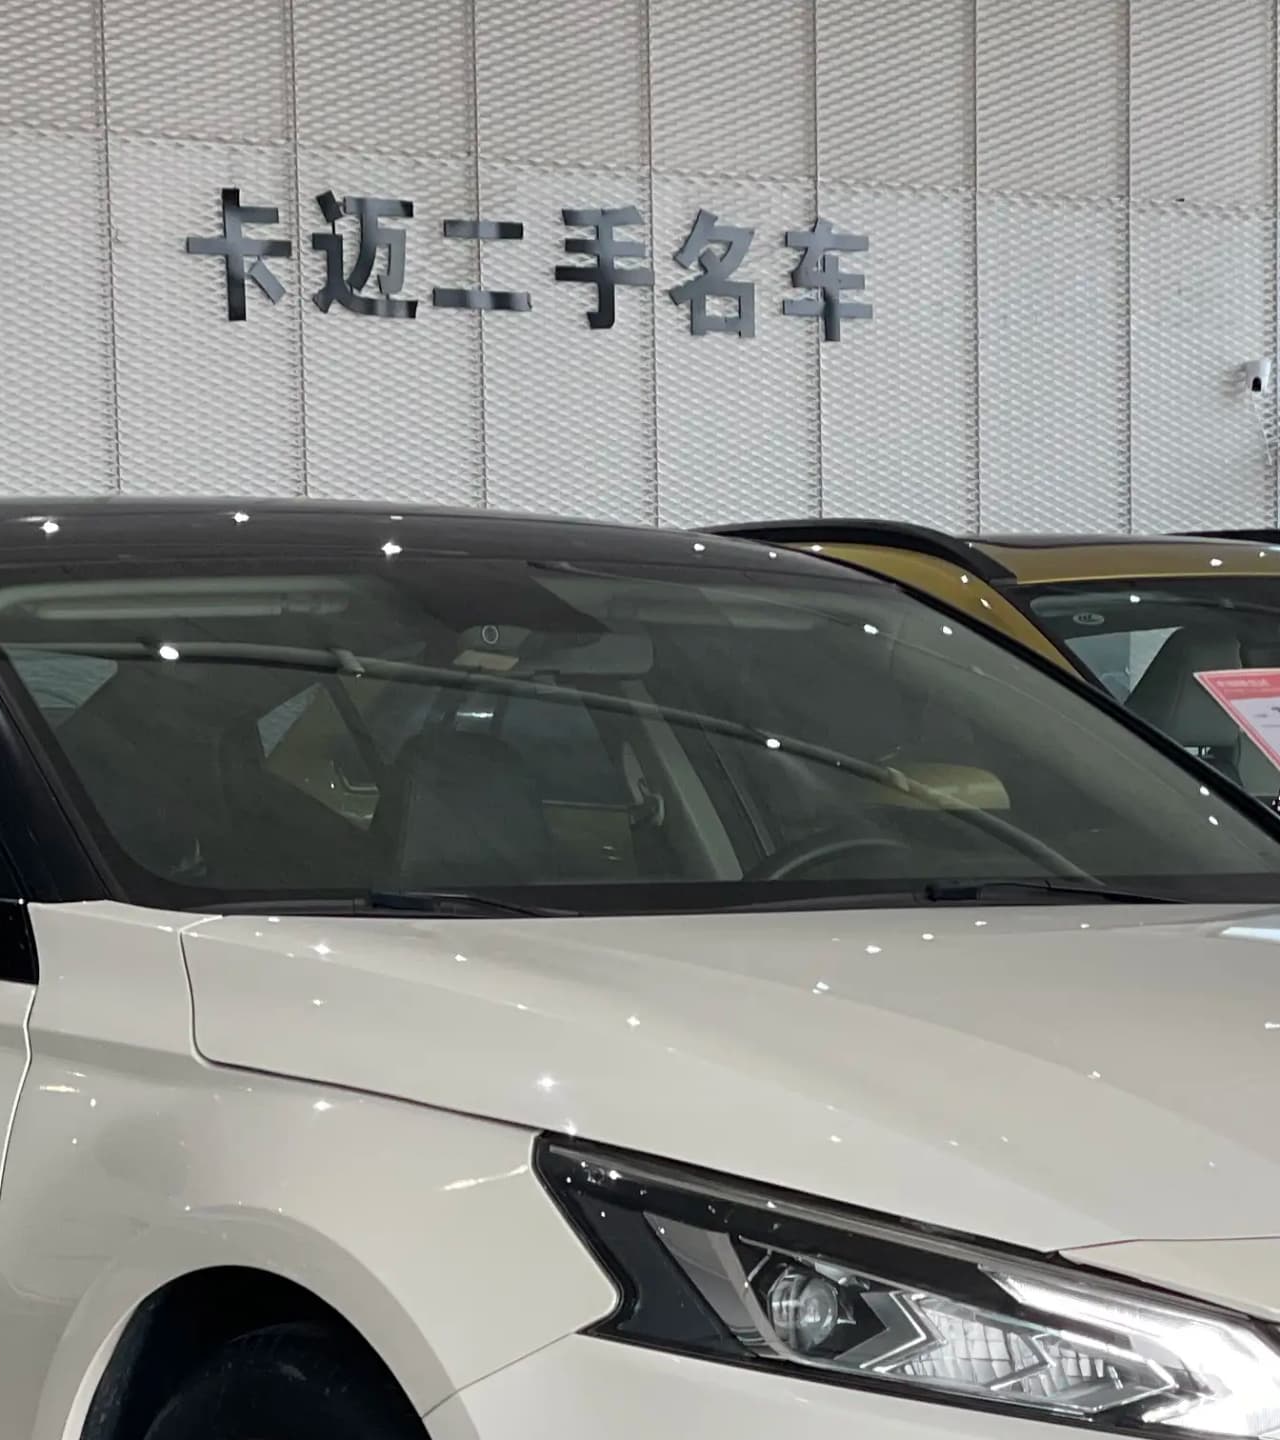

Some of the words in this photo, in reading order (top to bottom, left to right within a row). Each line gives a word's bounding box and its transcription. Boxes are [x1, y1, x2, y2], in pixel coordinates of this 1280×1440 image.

[186, 188, 874, 341] 卡迈二手名车
